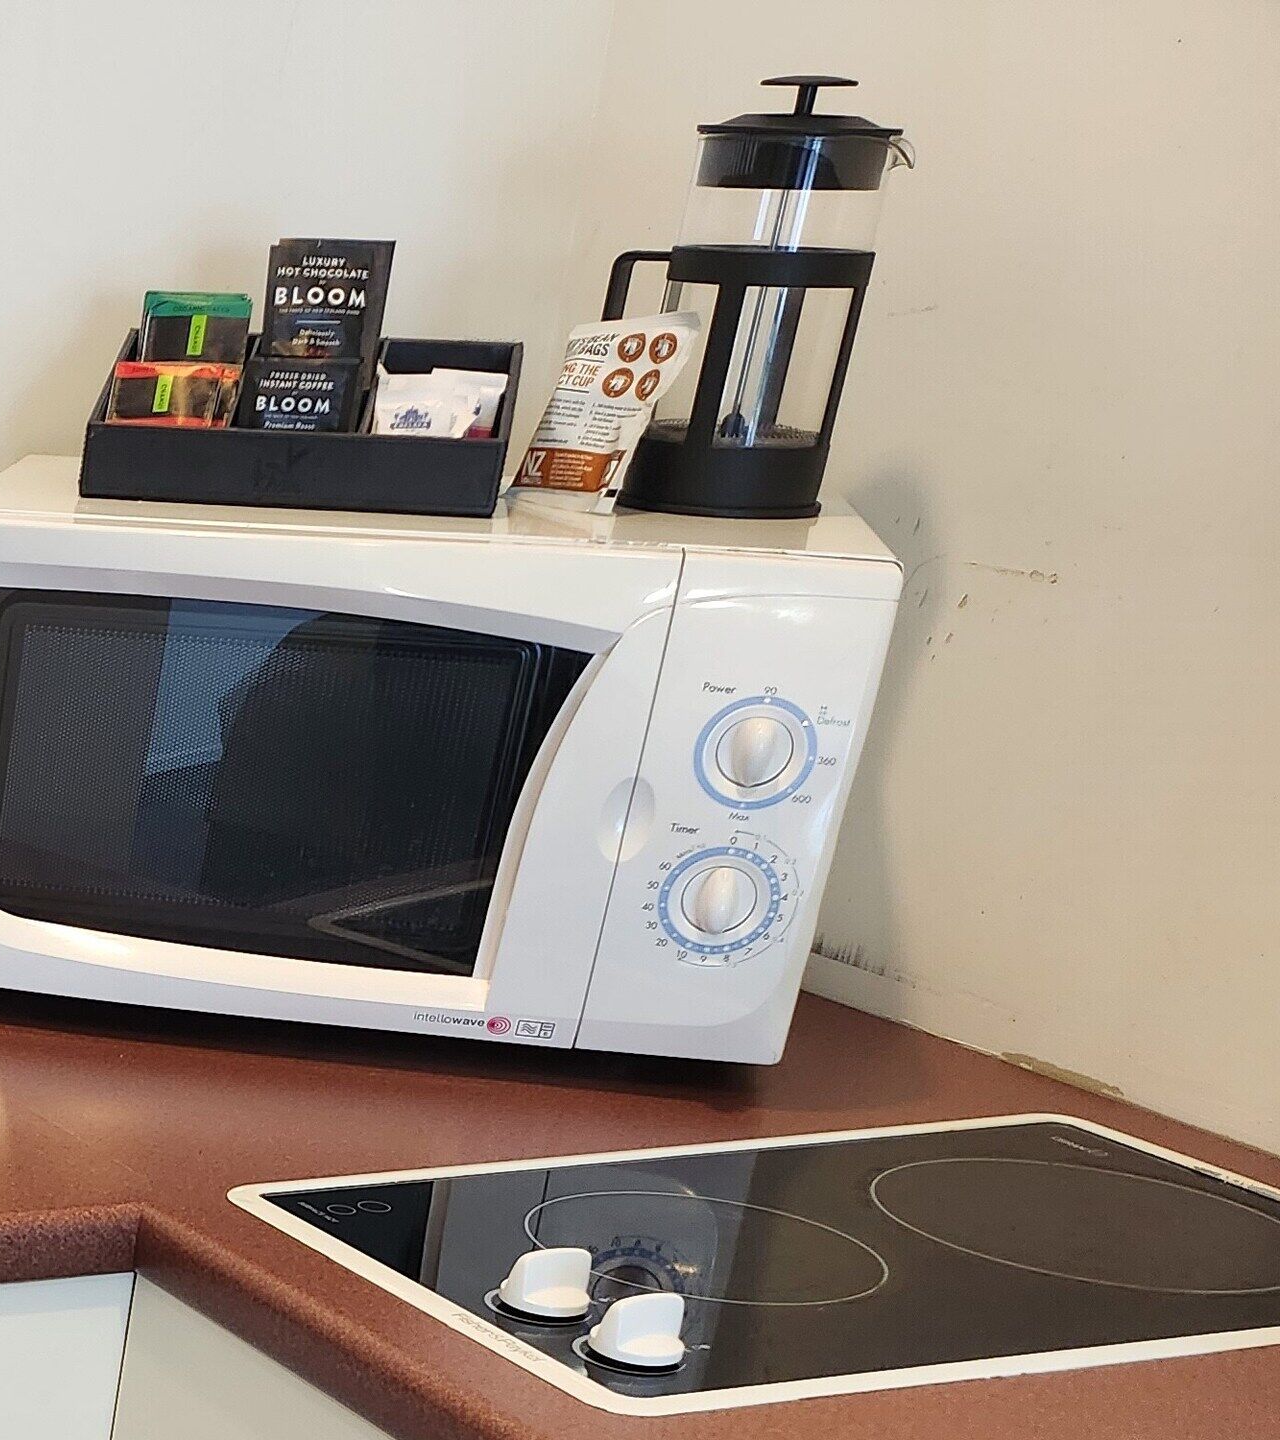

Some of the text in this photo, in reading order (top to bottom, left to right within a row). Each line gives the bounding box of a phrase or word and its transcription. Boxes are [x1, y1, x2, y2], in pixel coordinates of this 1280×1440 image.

[302, 256, 346, 267] LUXURY
[277, 266, 369, 280] HOT CHOCOLATE
[273, 286, 366, 309] BLOOM
[579, 364, 602, 376] THE
[260, 379, 334, 391] INSTANT COFFEE
[572, 375, 595, 387] CUP
[256, 395, 330, 414] BLOOM
[522, 450, 547, 477] NZ
[703, 682, 736, 694] Power
[764, 687, 778, 696] 90
[817, 756, 837, 766] 360
[792, 795, 811, 804] 600
[671, 823, 700, 834] Timer
[730, 836, 737, 845] 0
[770, 855, 778, 863] 2
[659, 862, 671, 870] 60
[781, 873, 787, 881] 3
[647, 881, 659, 890] 50
[642, 903, 654, 911] 40
[777, 914, 783, 922] 5
[645, 922, 658, 930] 30
[763, 932, 770, 940] 6
[656, 938, 668, 947] 20
[677, 950, 687, 959] 10
[414, 1011, 485, 1027] intellowave
